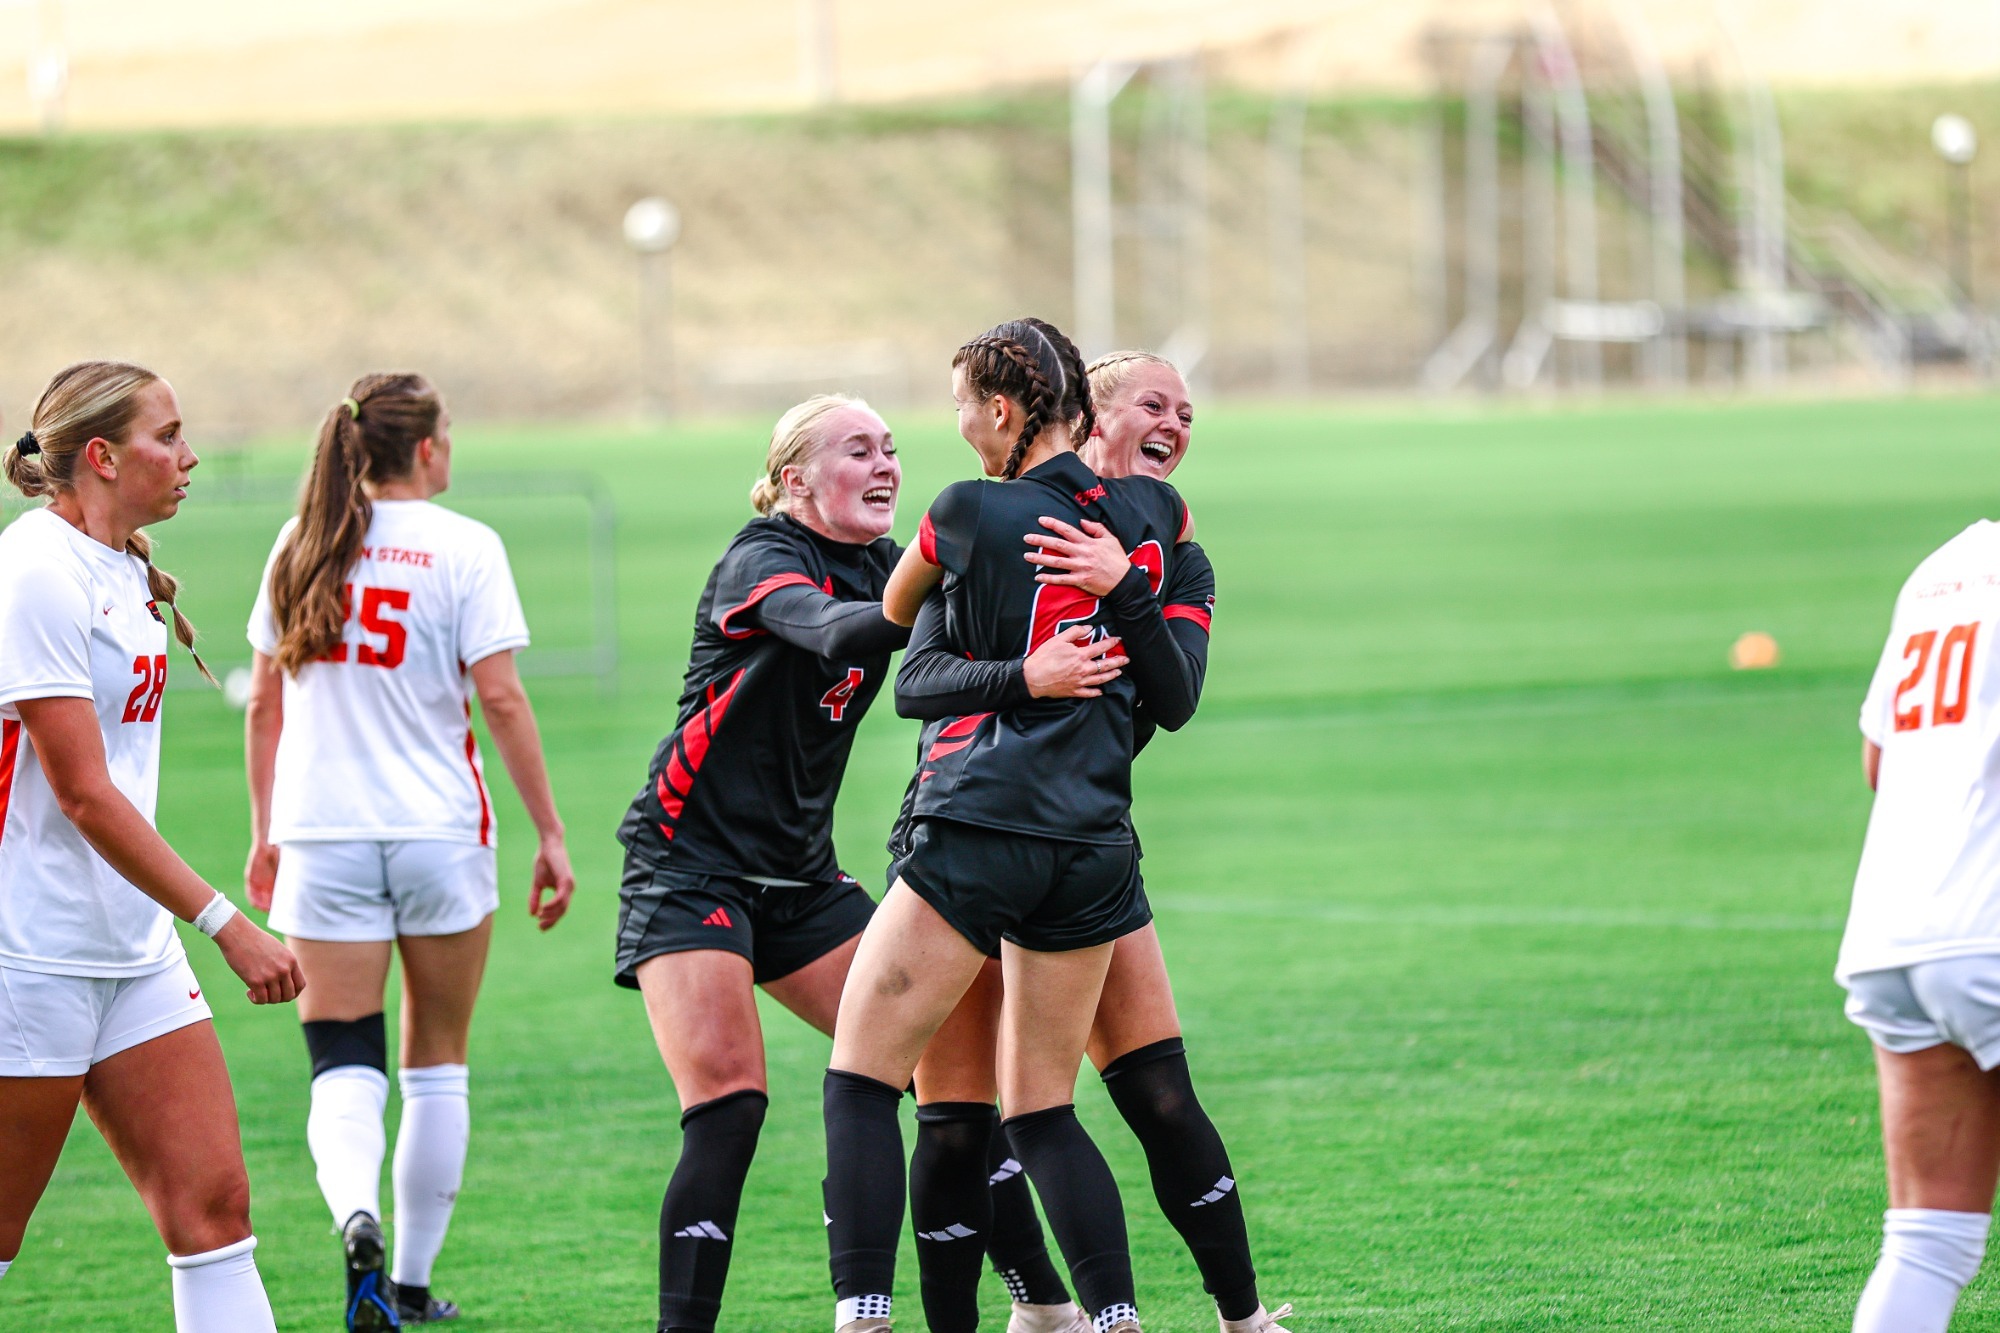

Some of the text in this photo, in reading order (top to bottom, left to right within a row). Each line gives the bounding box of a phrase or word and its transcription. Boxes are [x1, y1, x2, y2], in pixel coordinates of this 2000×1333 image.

[377, 547, 434, 569] STATE
[121, 654, 167, 724] 28
[820, 667, 864, 722] 4
[1895, 621, 1981, 733] 20
